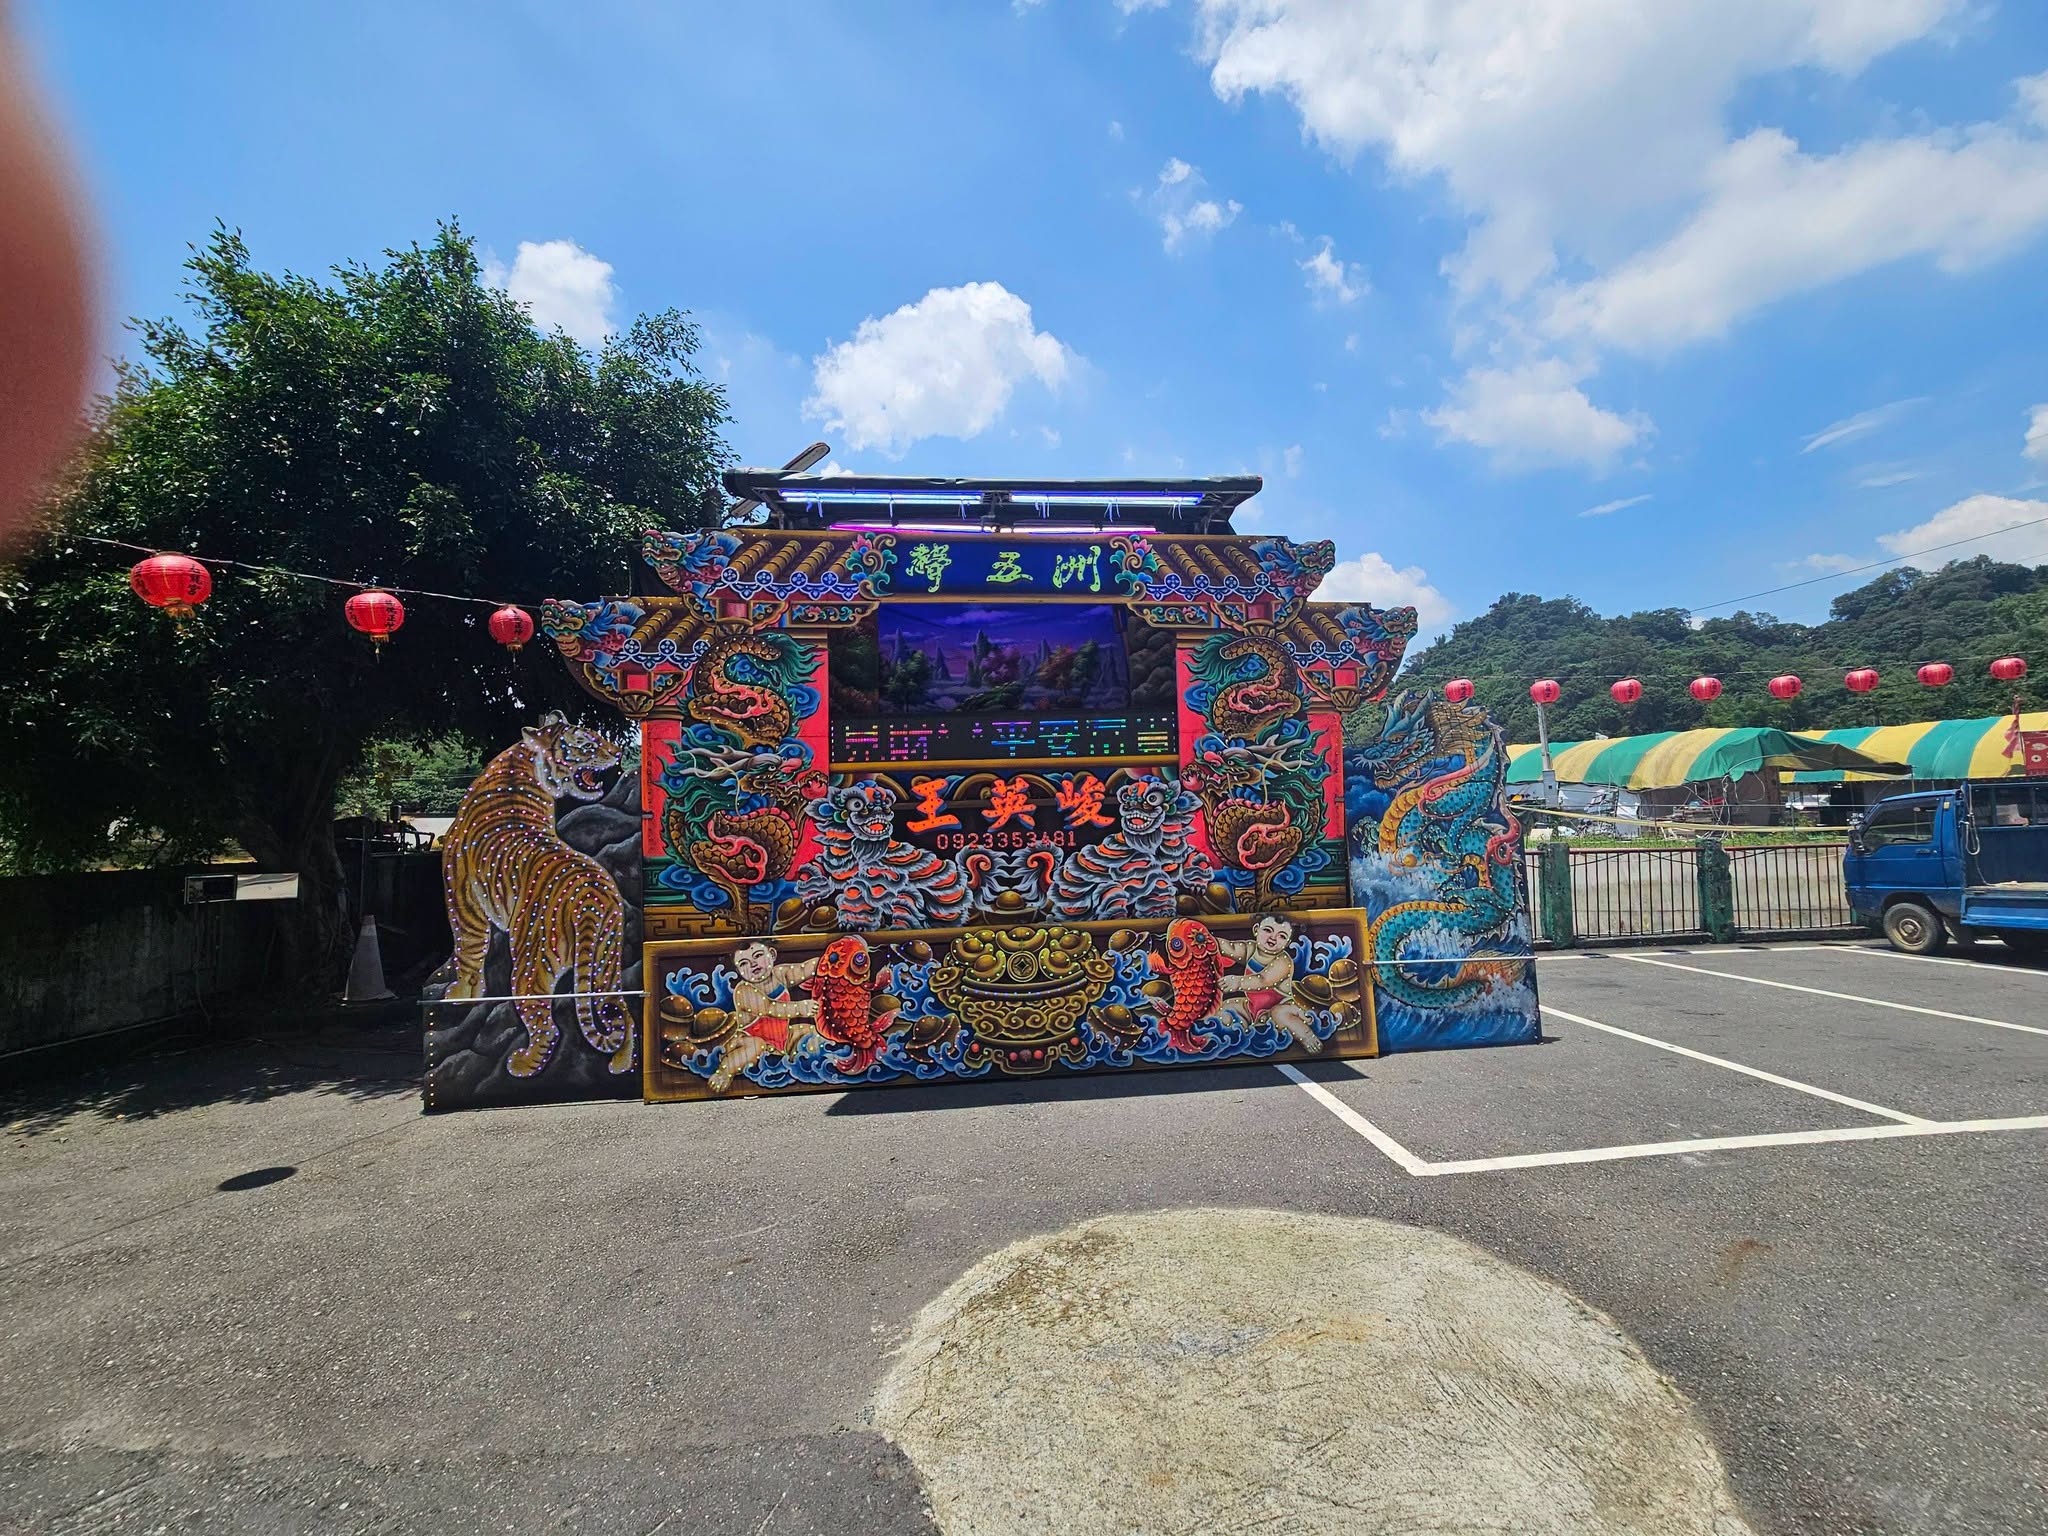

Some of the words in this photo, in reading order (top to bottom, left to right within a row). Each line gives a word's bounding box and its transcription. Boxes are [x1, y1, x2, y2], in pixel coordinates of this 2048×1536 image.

[906, 775, 1116, 834] 王英峻
[936, 830, 1077, 850] 0923353481
